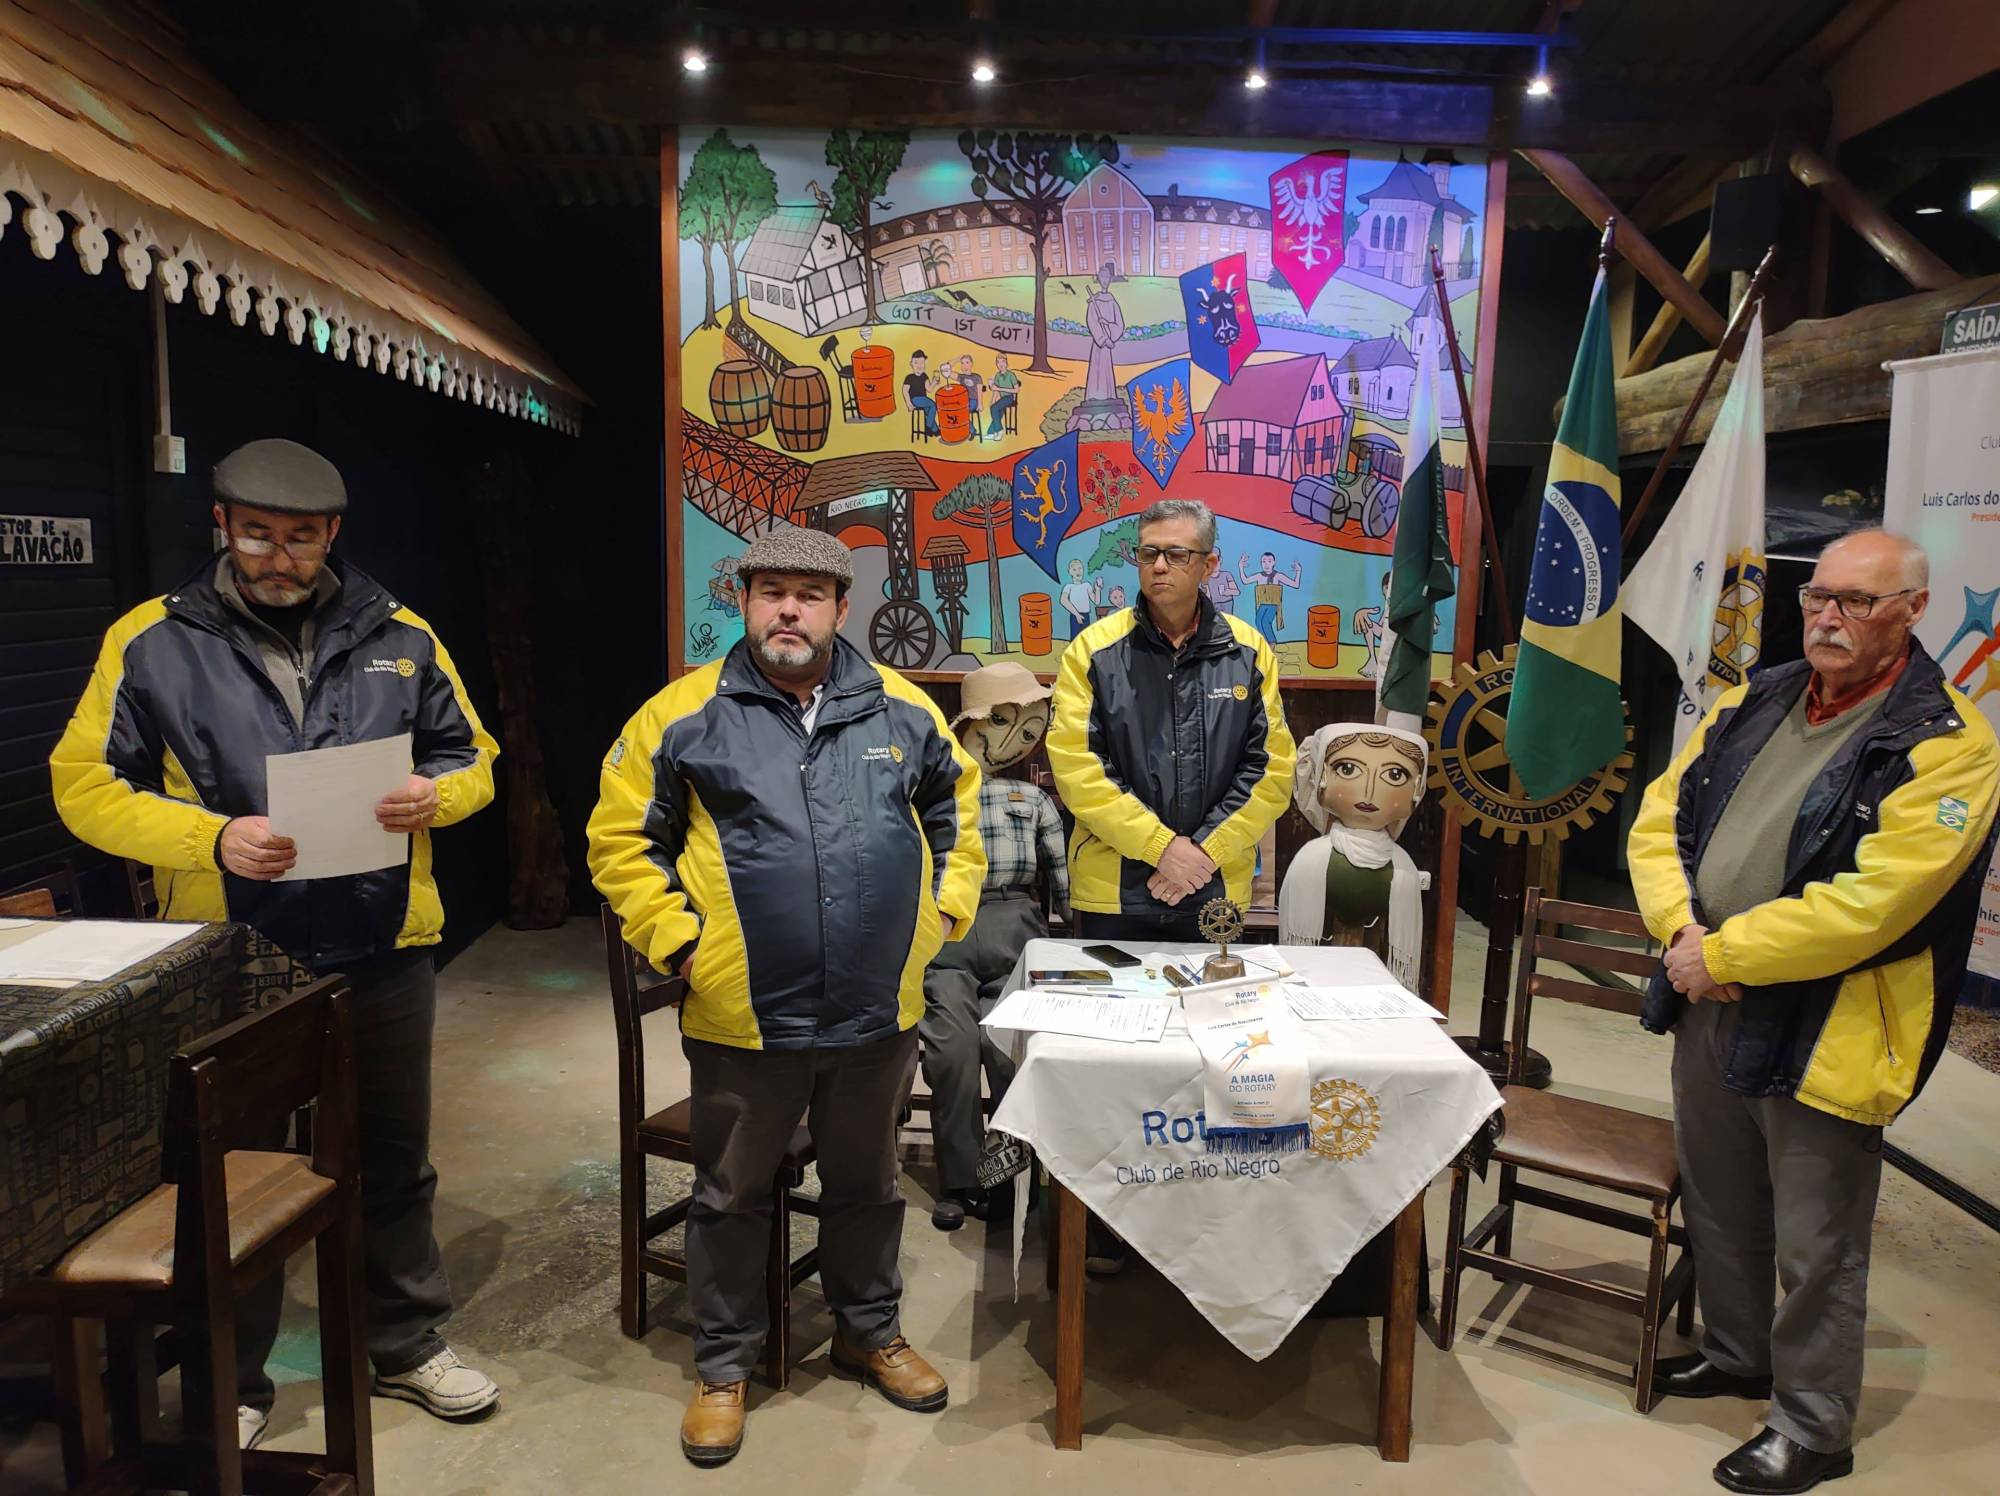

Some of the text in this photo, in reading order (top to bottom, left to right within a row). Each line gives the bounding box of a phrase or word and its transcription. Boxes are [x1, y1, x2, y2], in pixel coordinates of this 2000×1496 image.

[892, 304, 935, 321] GOTT
[954, 318, 977, 333] IST
[1922, 489, 2000, 507] Luis Carlos do
[830, 503, 843, 513] RIO
[41, 520, 56, 536] DE
[1549, 491, 1581, 528] ORDEM
[1581, 536, 1599, 612] PROGRESSO
[372, 658, 397, 668] Rotary
[1445, 762, 1597, 824] INTERNATIONAL
[1235, 990, 1257, 999] Rotary
[1229, 1083, 1277, 1093] DO ROTARY
[1231, 1073, 1275, 1085] A MAGIA
[1142, 1110, 1209, 1147] Rot
[1116, 1157, 1281, 1185] Club de Rio Negro
[980, 1172, 1006, 1190] ORTER
